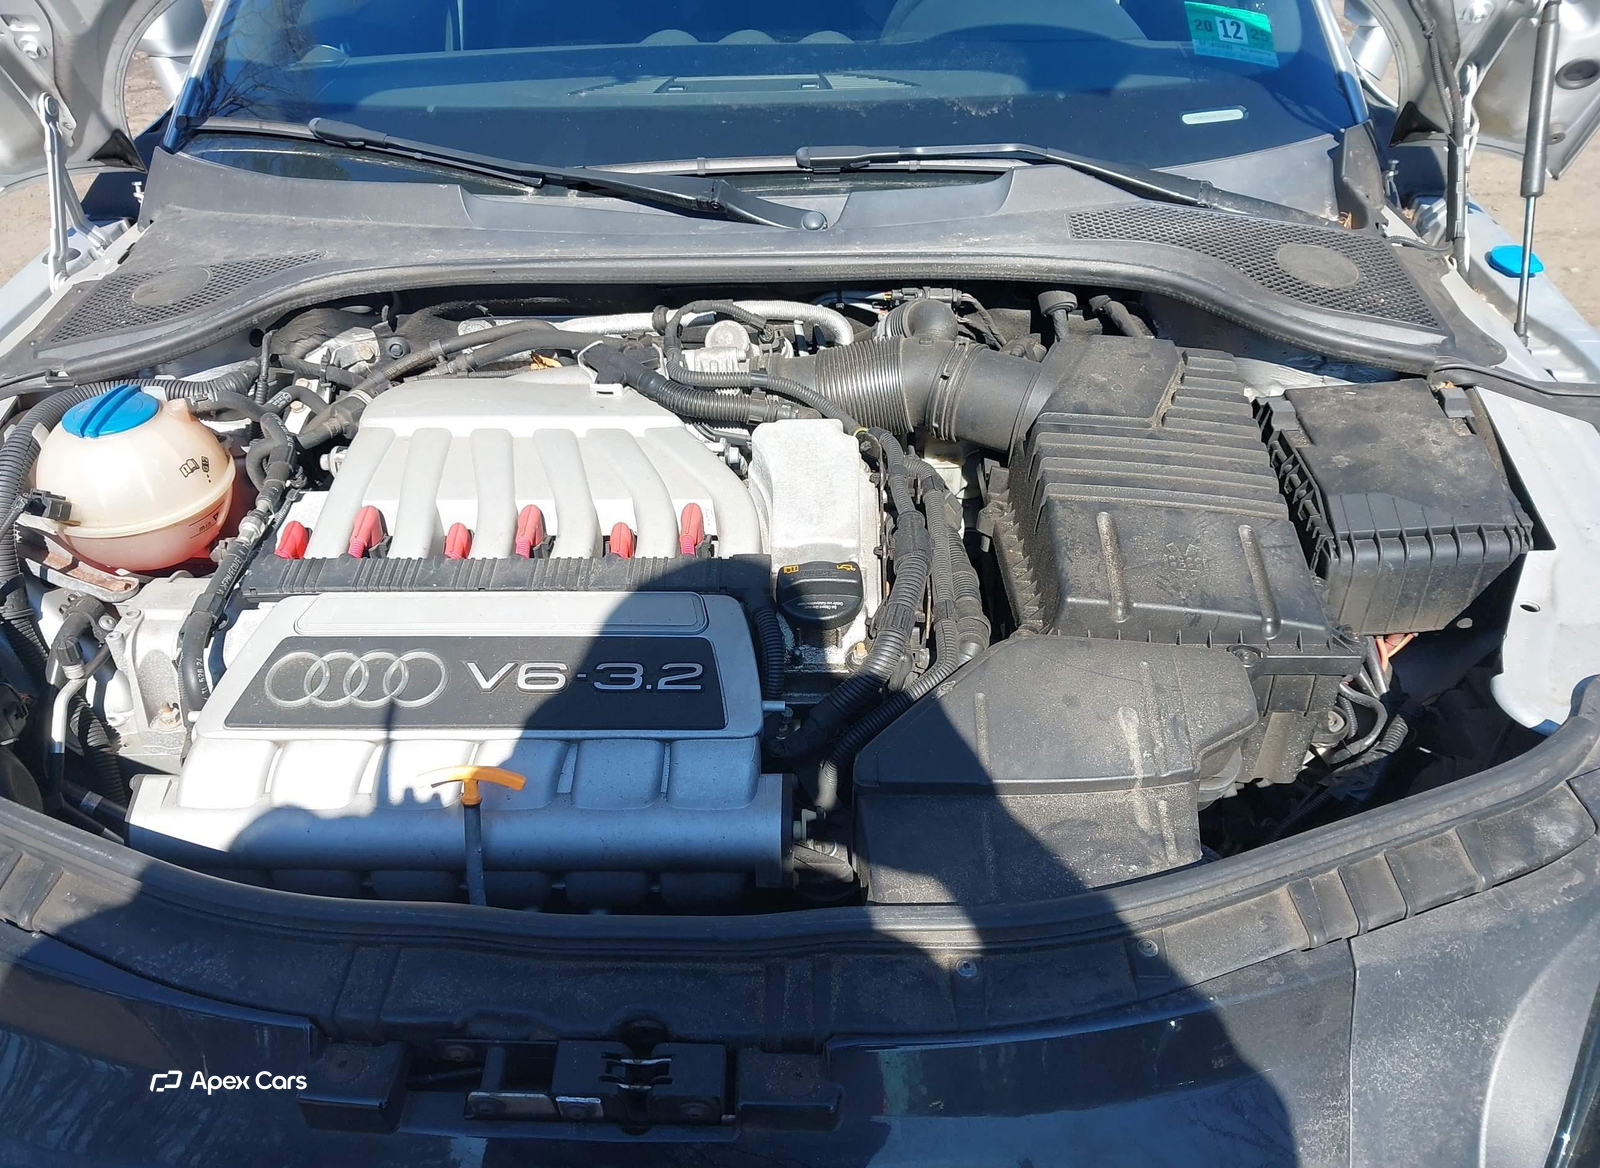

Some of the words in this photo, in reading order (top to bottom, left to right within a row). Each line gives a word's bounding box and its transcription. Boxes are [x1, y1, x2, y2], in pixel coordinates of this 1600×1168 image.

[1194, 19, 1213, 32] 20
[1219, 19, 1243, 40] 12
[1250, 28, 1268, 42] 25
[199, 521, 212, 532] min
